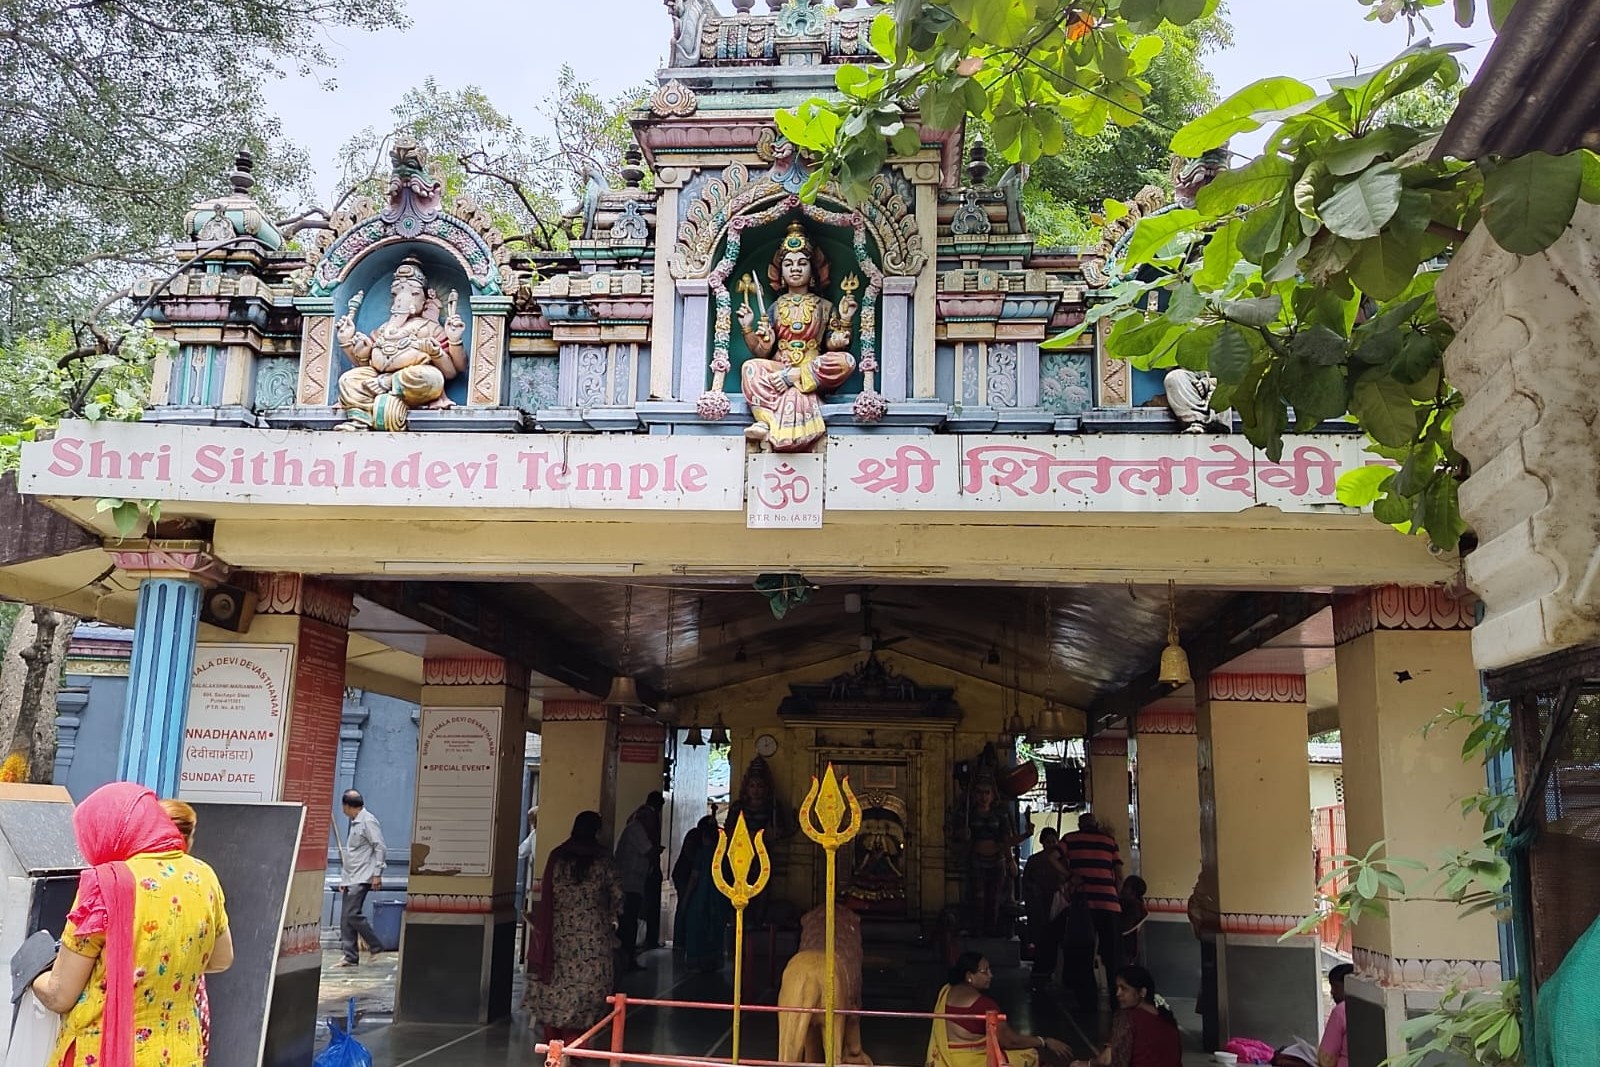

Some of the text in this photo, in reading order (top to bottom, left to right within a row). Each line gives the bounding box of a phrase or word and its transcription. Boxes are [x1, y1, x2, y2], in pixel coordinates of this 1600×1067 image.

[48, 438, 708, 499] Shri Sithaladevi Temple
[850, 444, 940, 493] श्री
[191, 657, 278, 717] HALA DEVI DEVASTHANAM
[185, 729, 267, 740] NNADHANAM
[181, 772, 255, 783] SUNDAY DATE
